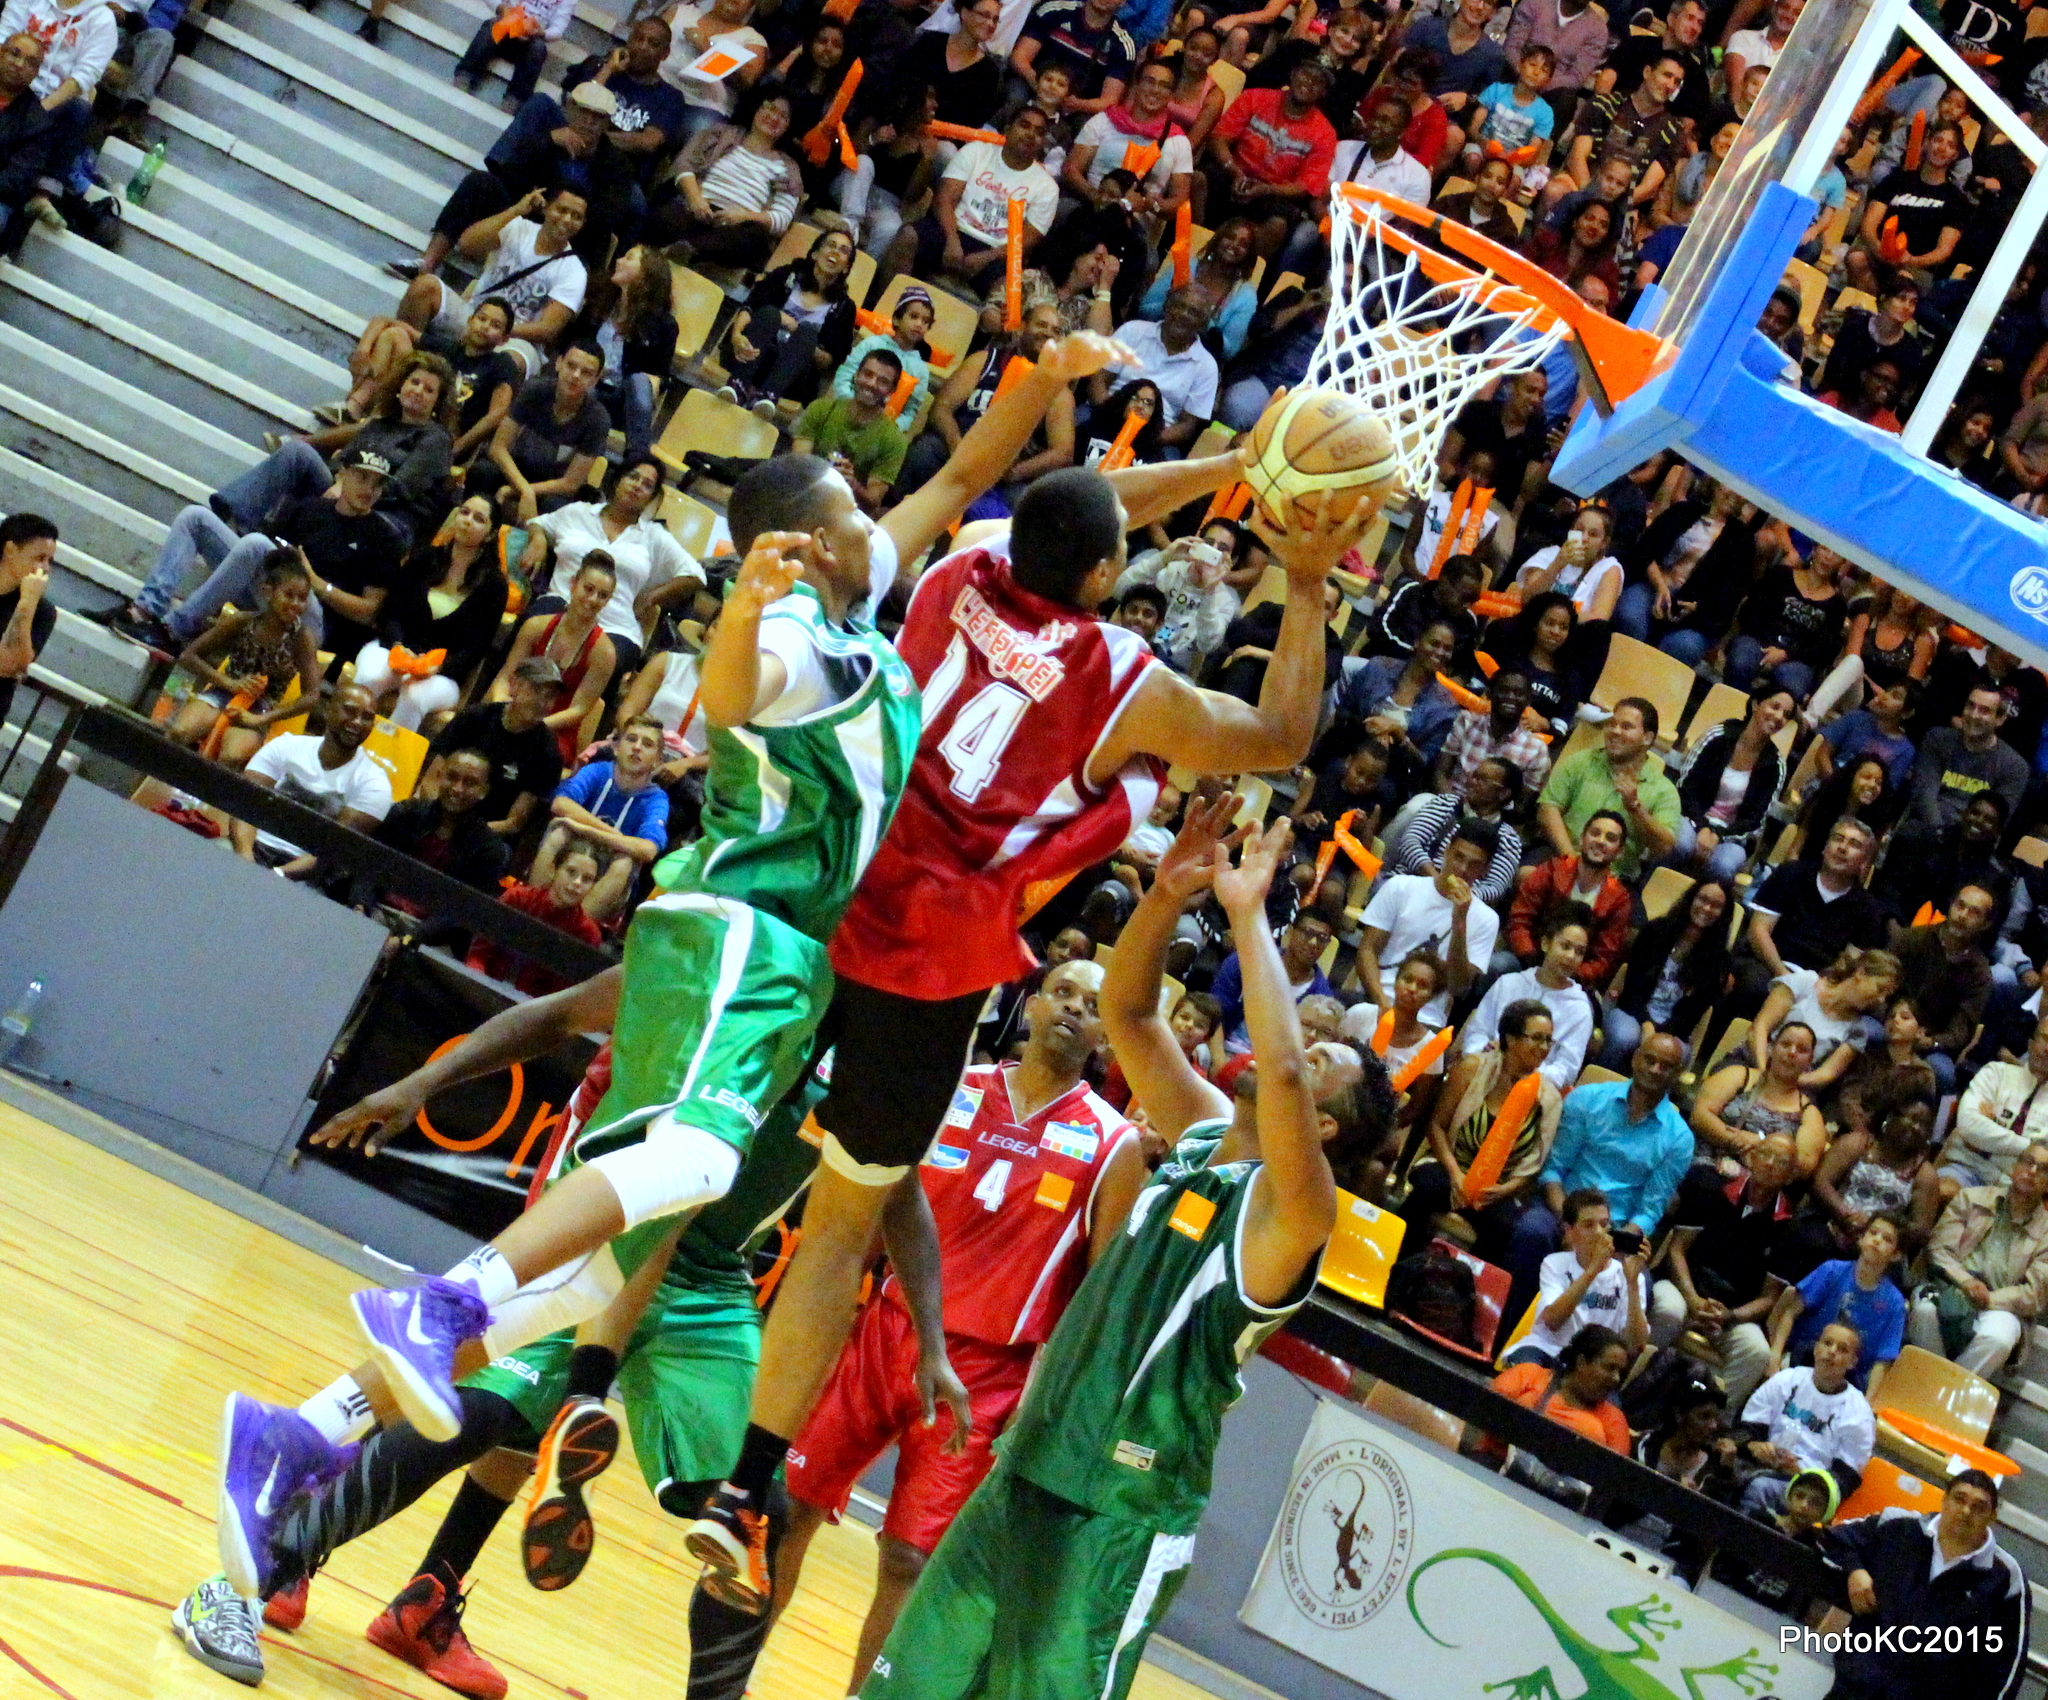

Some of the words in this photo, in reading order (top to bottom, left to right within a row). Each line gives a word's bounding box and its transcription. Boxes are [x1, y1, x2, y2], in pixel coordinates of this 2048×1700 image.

[976, 1130, 1039, 1159] LEGEA
[972, 1158, 1014, 1213] 4
[1310, 1449, 1342, 1478] MADE
[1300, 1474, 1313, 1491] IN
[1359, 1446, 1408, 1522] L'ORIGINAL
[1397, 1528, 1408, 1552] BY
[1284, 1549, 1301, 1589] SINCE
[1330, 1610, 1357, 1625] PEI
